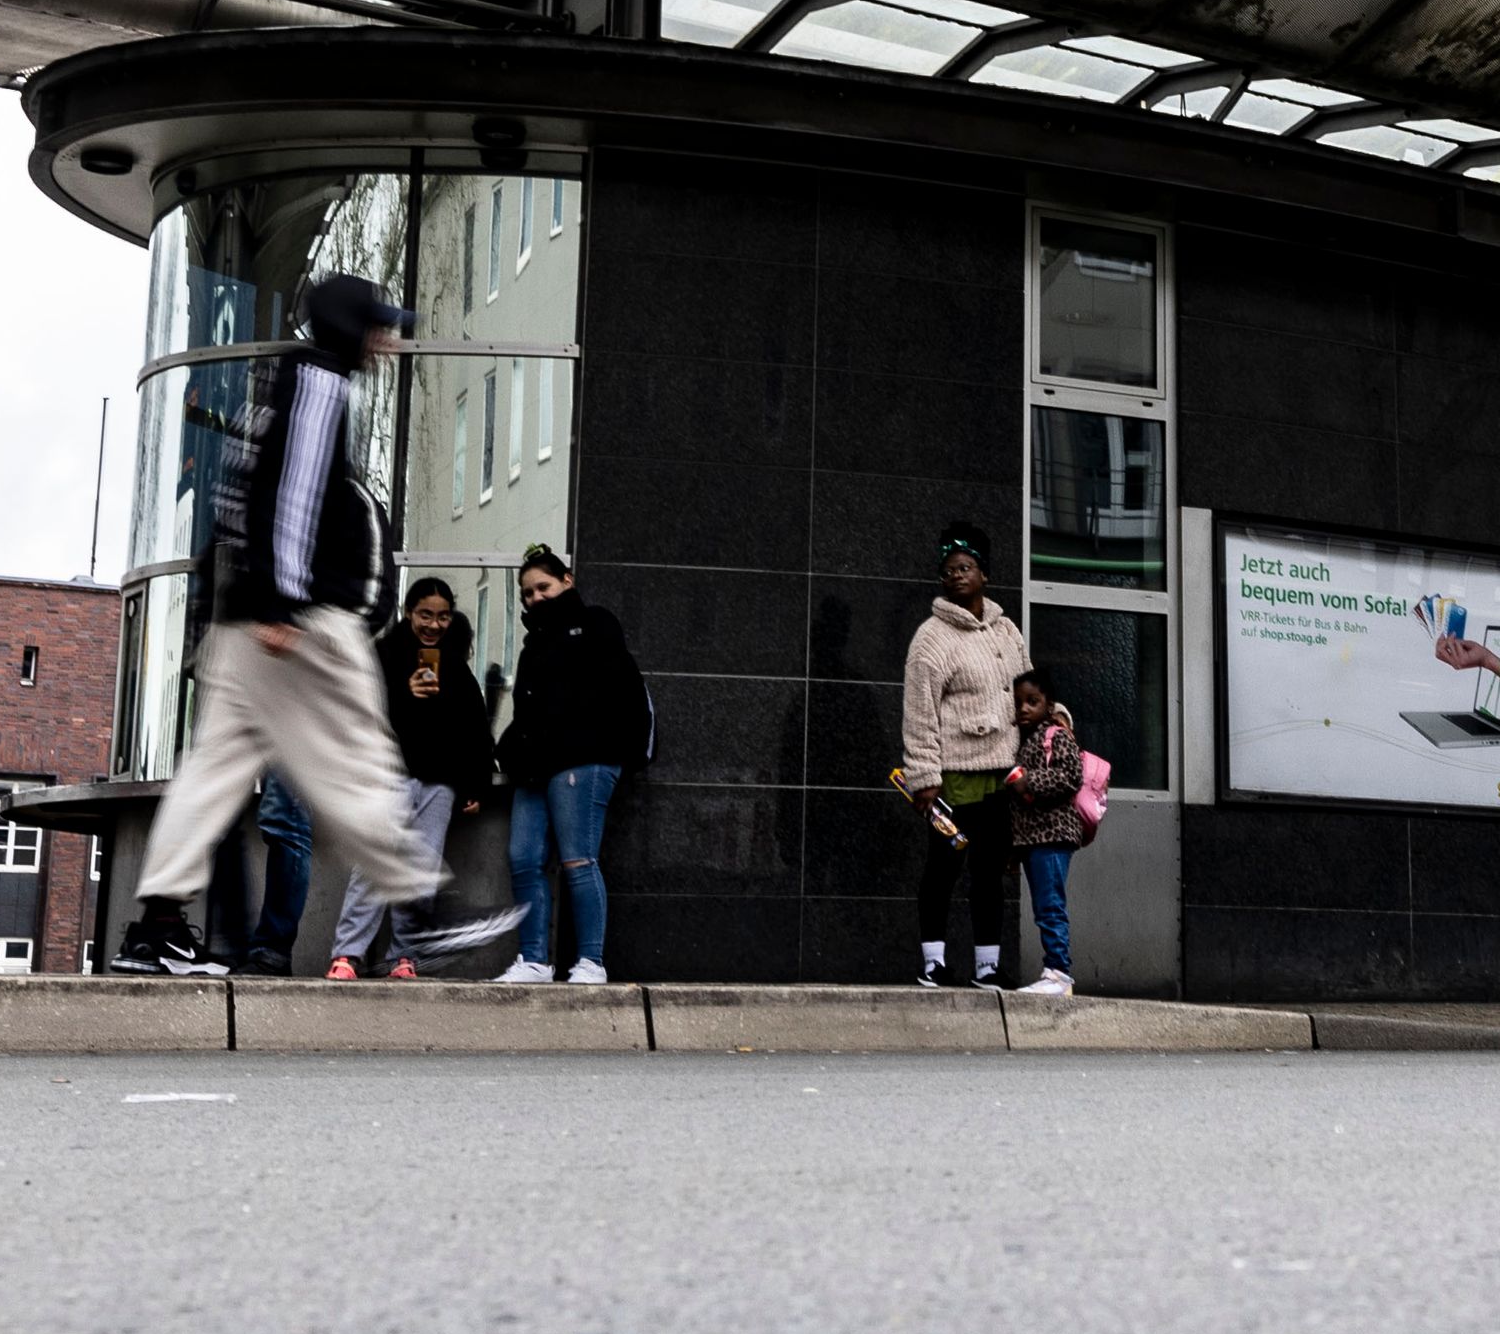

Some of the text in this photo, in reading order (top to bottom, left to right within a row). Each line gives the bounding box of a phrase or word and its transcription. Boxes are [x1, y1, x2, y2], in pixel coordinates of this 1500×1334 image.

[1240, 553, 1331, 582] Jetzt auch
[1240, 579, 1407, 617] bequem vom Sofa!
[1240, 609, 1368, 634] VRR-Tickets für Bus & Bahn
[1241, 626, 1327, 646] auf shop.stoag.de
